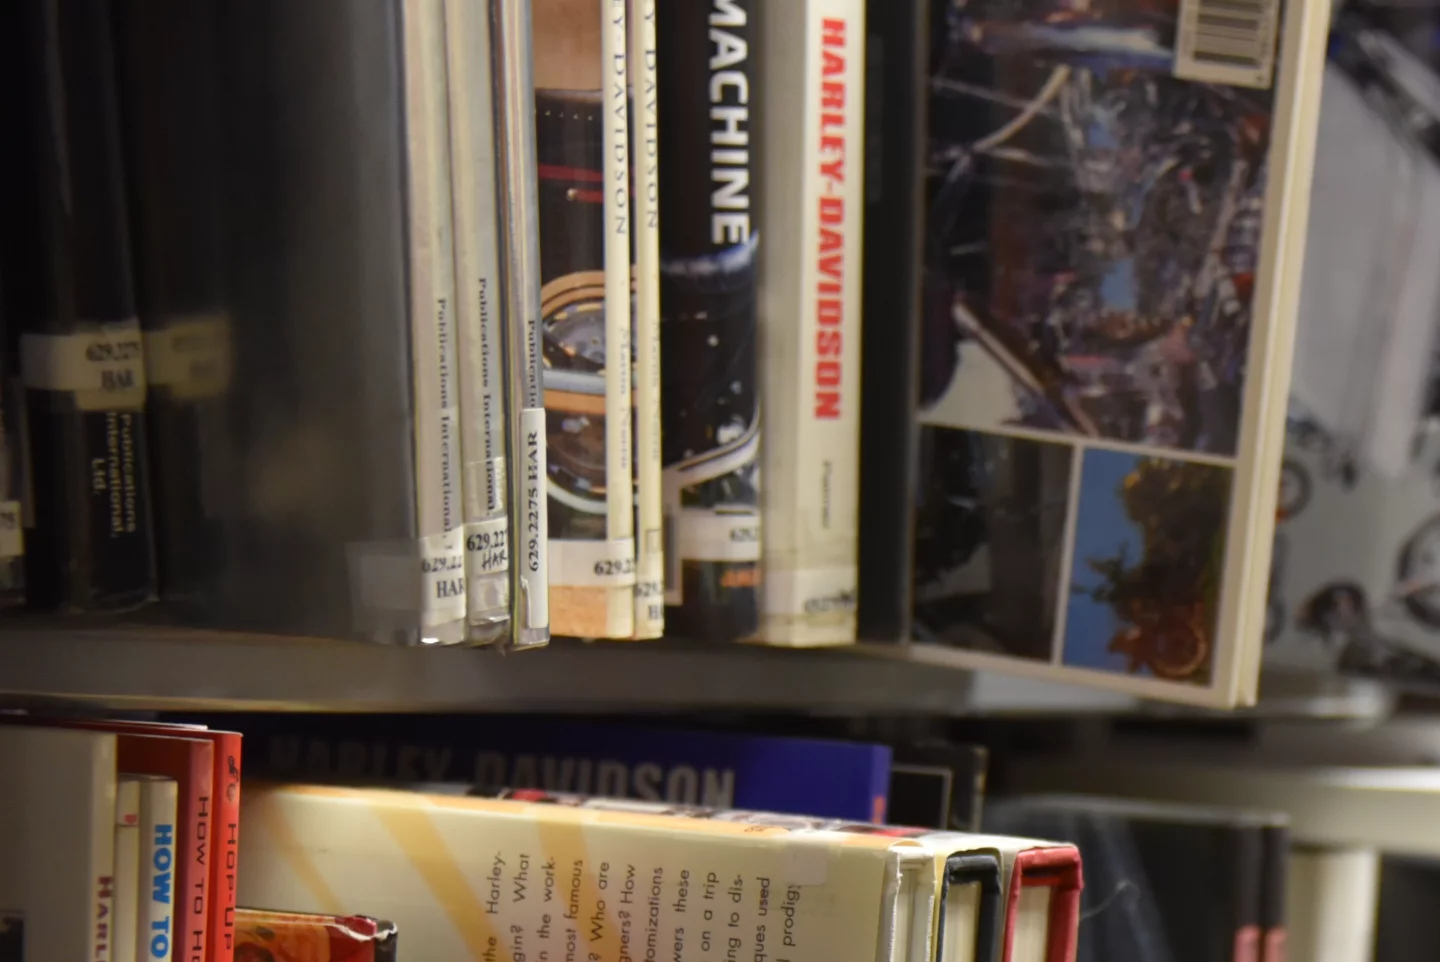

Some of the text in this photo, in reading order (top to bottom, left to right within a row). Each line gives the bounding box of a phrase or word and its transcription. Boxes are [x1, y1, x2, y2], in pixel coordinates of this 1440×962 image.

[815, 17, 846, 419] HARLEY-DAVIDSON
[527, 320, 537, 408] Publicatio
[121, 413, 136, 532] Publications
[527, 431, 539, 572] 629.2275 HAR
[196, 796, 209, 866] HOW
[152, 824, 173, 904] HOW
[511, 853, 531, 904] What
[597, 861, 611, 891] are
[619, 863, 636, 905] How
[193, 878, 204, 916] TO
[223, 823, 237, 950] HOP-UP
[562, 859, 584, 920] famous
[671, 869, 690, 913] these
[702, 871, 721, 901] trip
[755, 876, 771, 917] used
[150, 915, 170, 958] TO
[535, 913, 552, 940] the
[589, 899, 606, 943] Who
[703, 908, 714, 922] a
[727, 911, 741, 928] to
[481, 936, 498, 962] the
[700, 930, 712, 952] on
